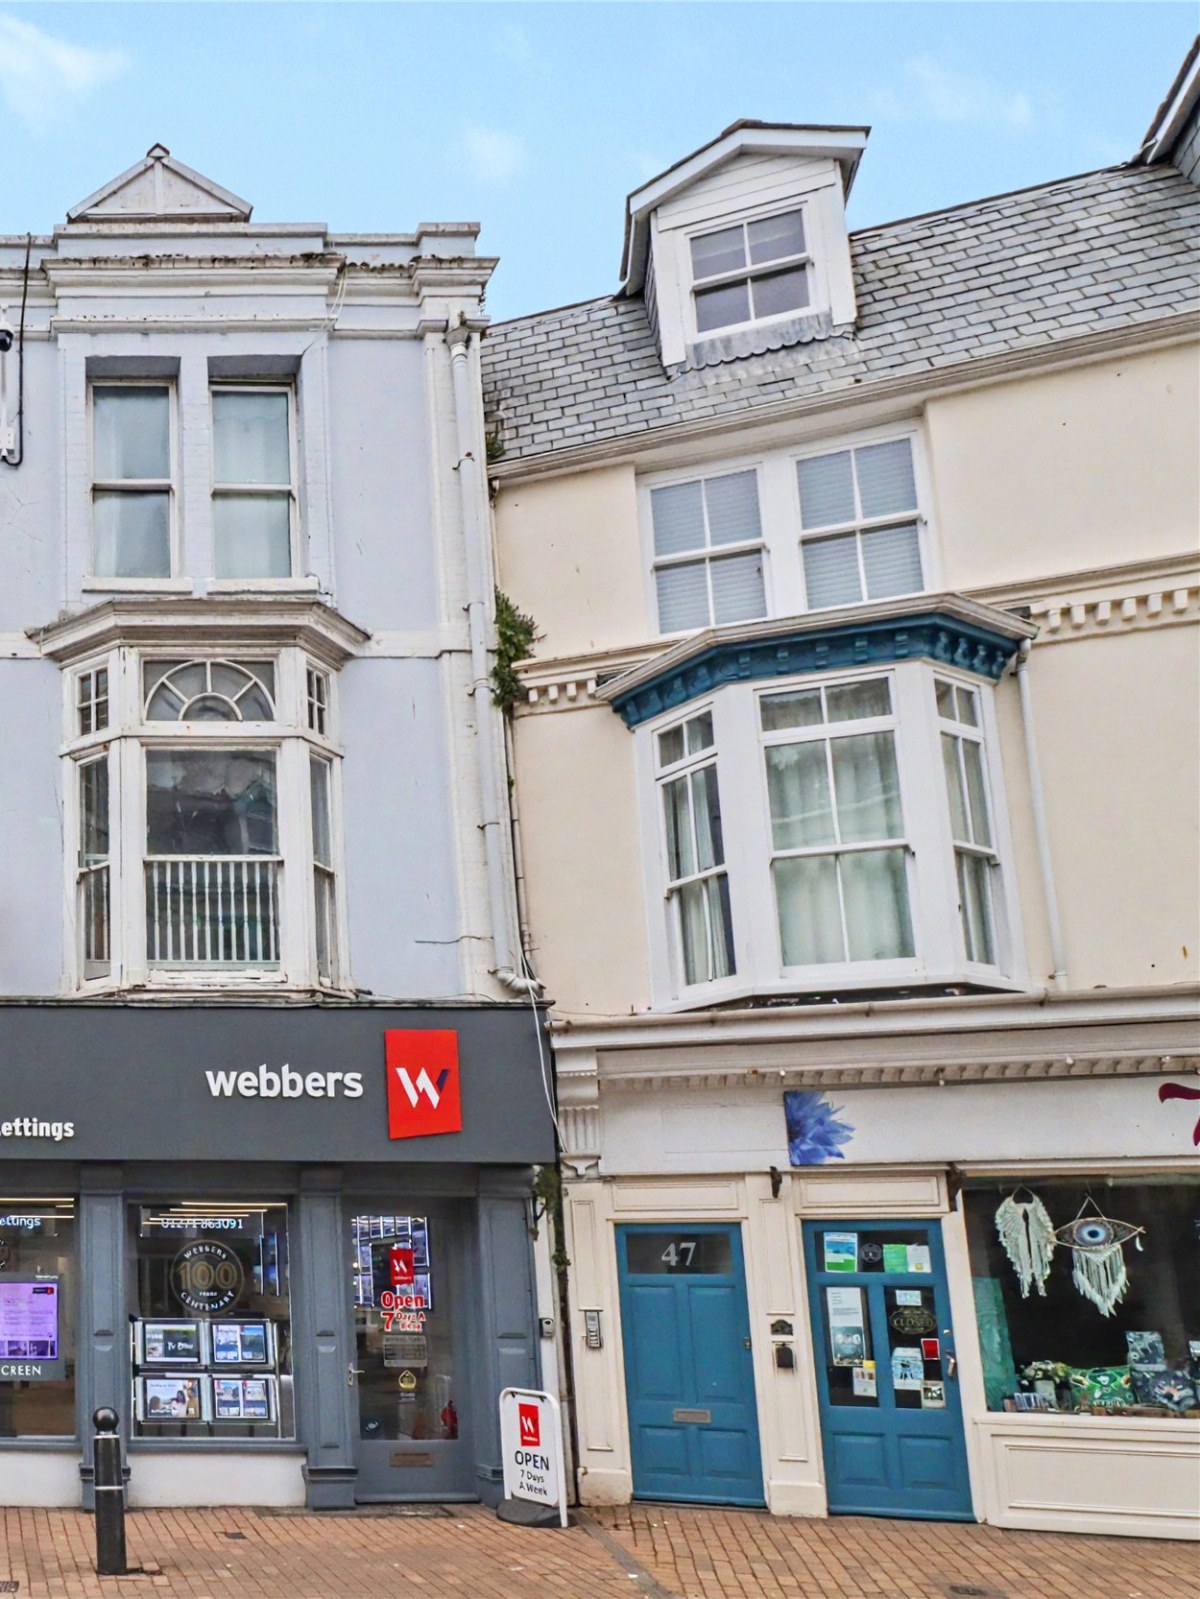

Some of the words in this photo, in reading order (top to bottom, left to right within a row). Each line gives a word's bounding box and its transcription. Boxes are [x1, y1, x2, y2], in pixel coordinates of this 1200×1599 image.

[204, 1063, 364, 1099] webbers
[661, 1242, 697, 1266] 47
[176, 1260, 238, 1291] 100
[180, 1290, 235, 1312] CENTENARY
[381, 1291, 425, 1310] Open
[381, 1311, 395, 1332] 7
[514, 1450, 550, 1471] OPEN
[520, 1468, 525, 1478] 7
[526, 1470, 545, 1483] Days
[519, 1481, 526, 1491] A
[526, 1483, 548, 1496] Week
